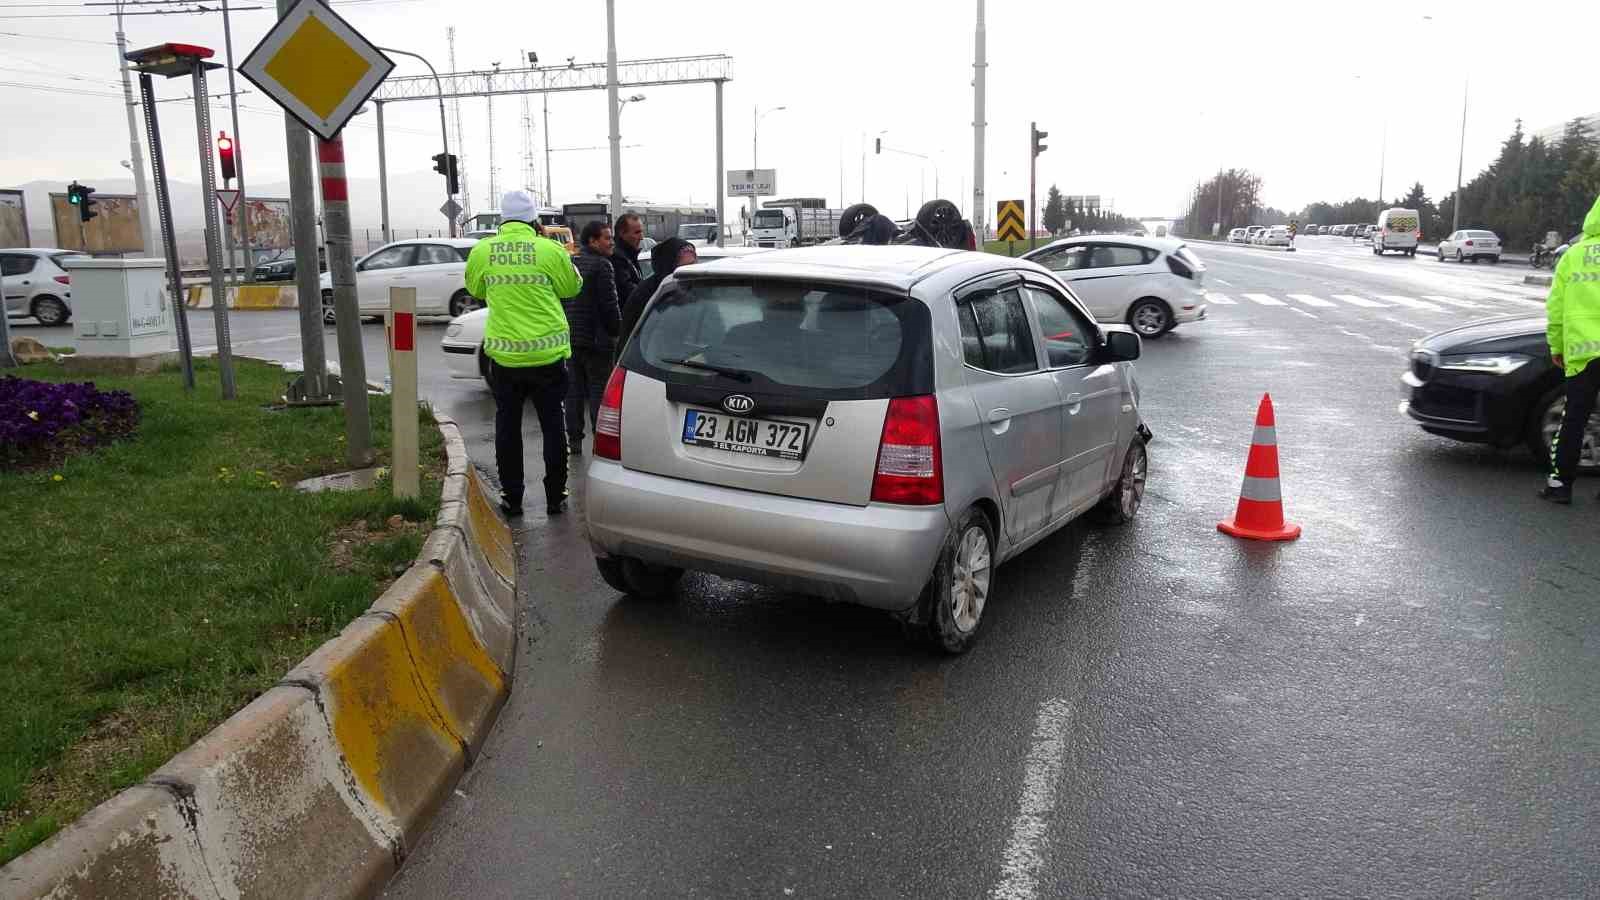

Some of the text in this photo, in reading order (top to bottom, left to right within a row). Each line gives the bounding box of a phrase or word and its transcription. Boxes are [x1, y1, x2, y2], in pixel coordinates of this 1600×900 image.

[728, 398, 749, 409] KIA
[695, 415, 717, 437] 23
[724, 419, 759, 445] AGN
[765, 424, 802, 450] 372
